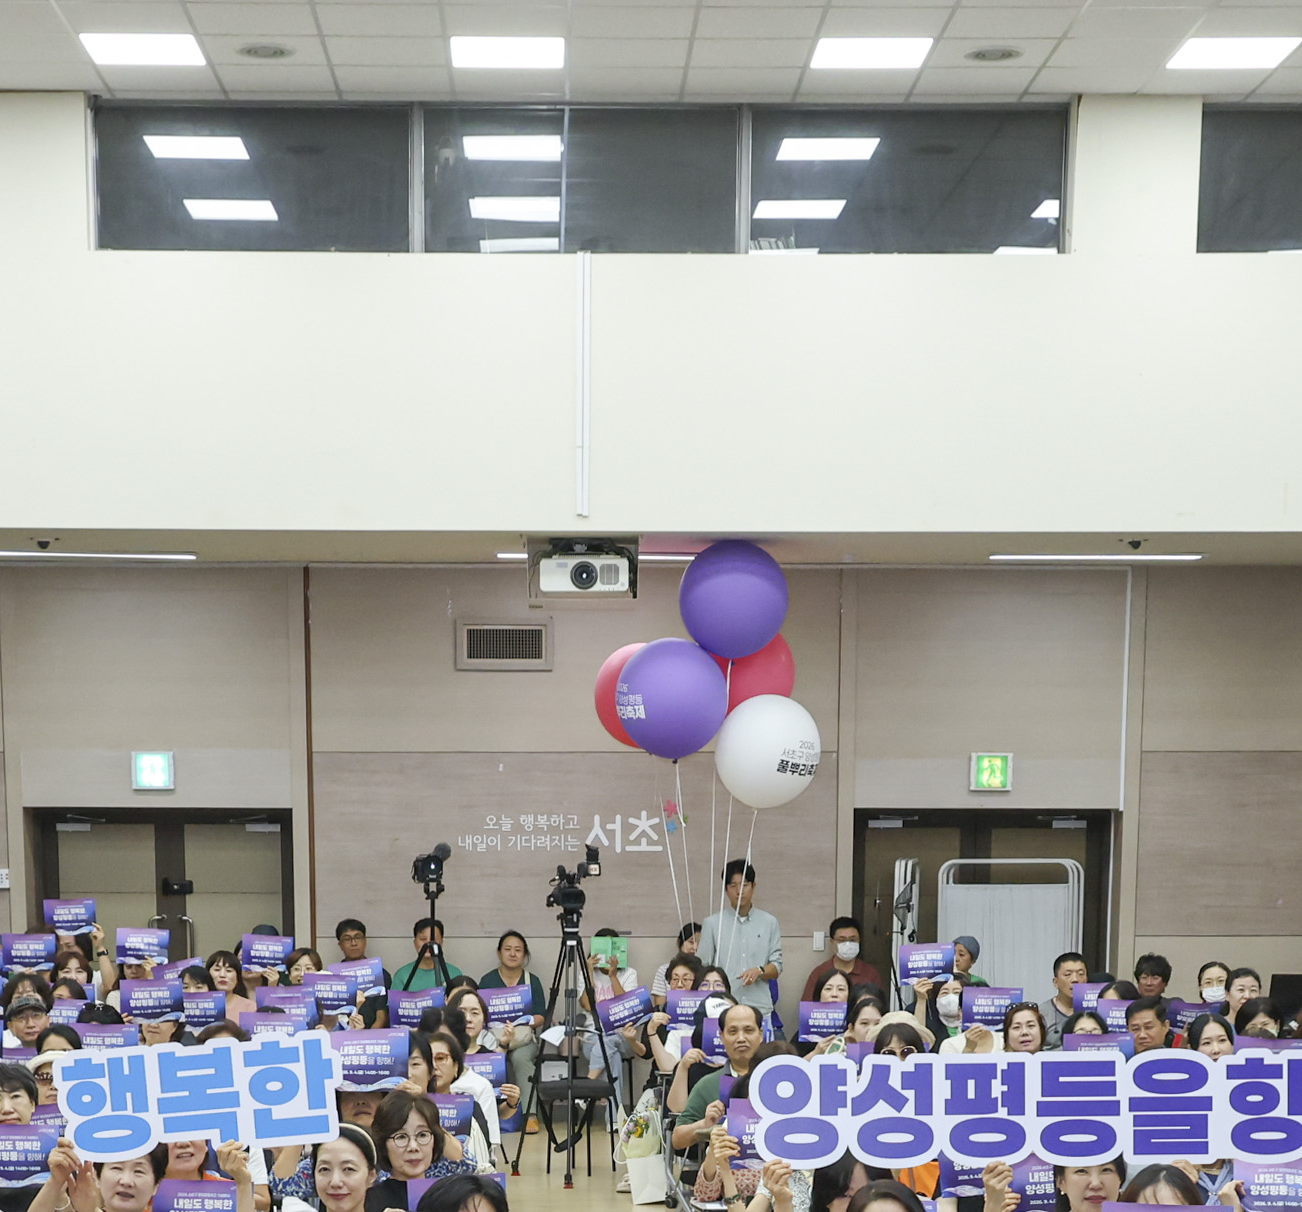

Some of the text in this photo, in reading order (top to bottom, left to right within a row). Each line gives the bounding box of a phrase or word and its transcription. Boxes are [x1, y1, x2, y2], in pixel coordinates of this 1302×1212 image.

[776, 758, 818, 776] 풀뿌리축
[484, 814, 580, 831] 오늘 행복하고
[585, 810, 663, 854] 서초
[458, 834, 581, 852] 내일이 기다려지는
[65, 1036, 332, 1157] 행복한
